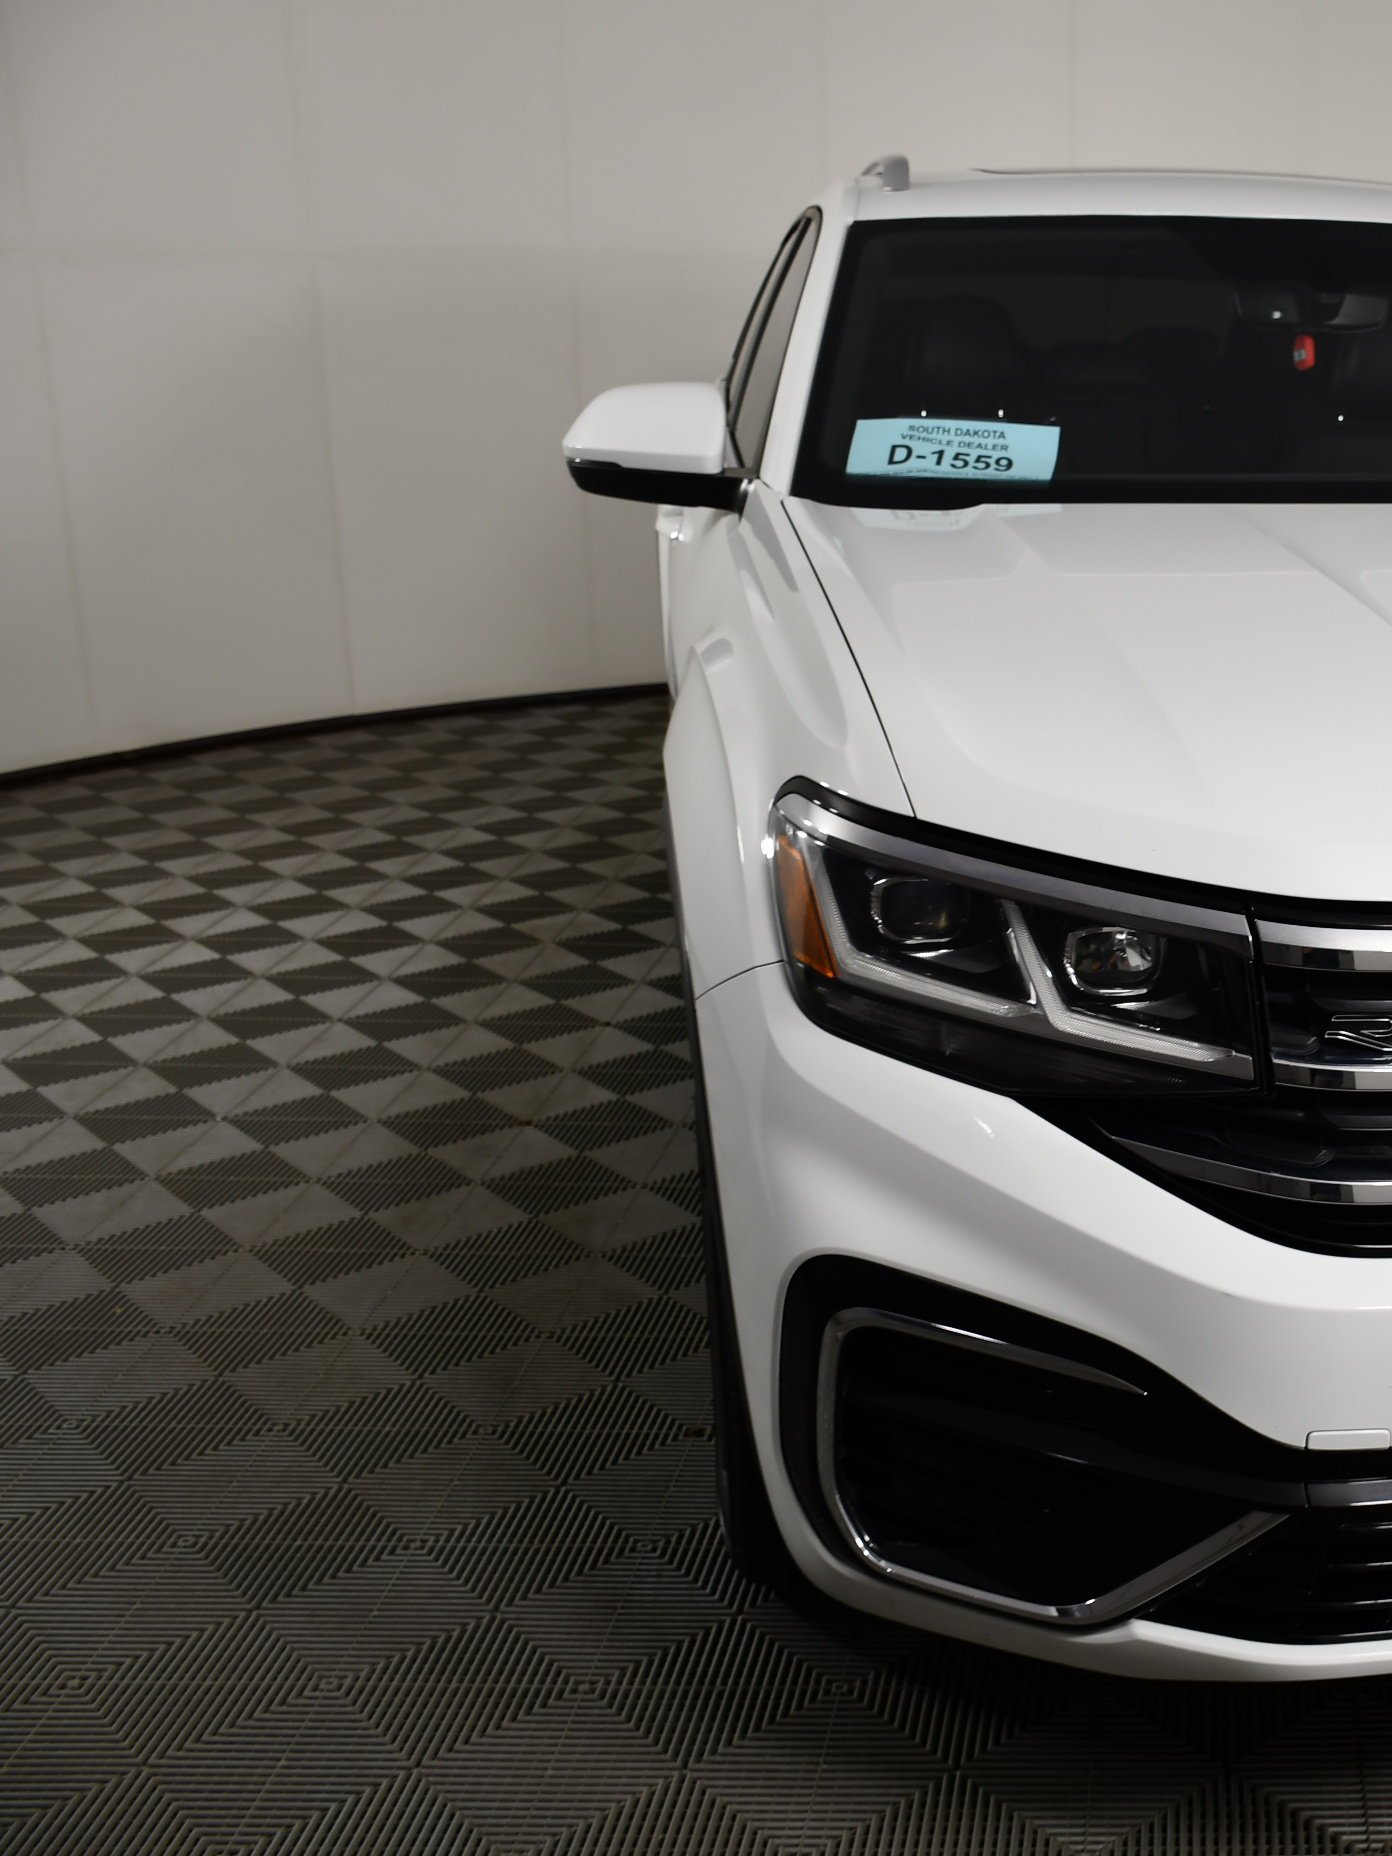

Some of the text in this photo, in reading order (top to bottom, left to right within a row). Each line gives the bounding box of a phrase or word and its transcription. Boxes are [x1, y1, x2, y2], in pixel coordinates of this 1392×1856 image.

[908, 425, 1006, 440] SOUTH DAKOTA
[901, 433, 1009, 452] VEHICLE DEALER
[887, 444, 1014, 472] D-1559
